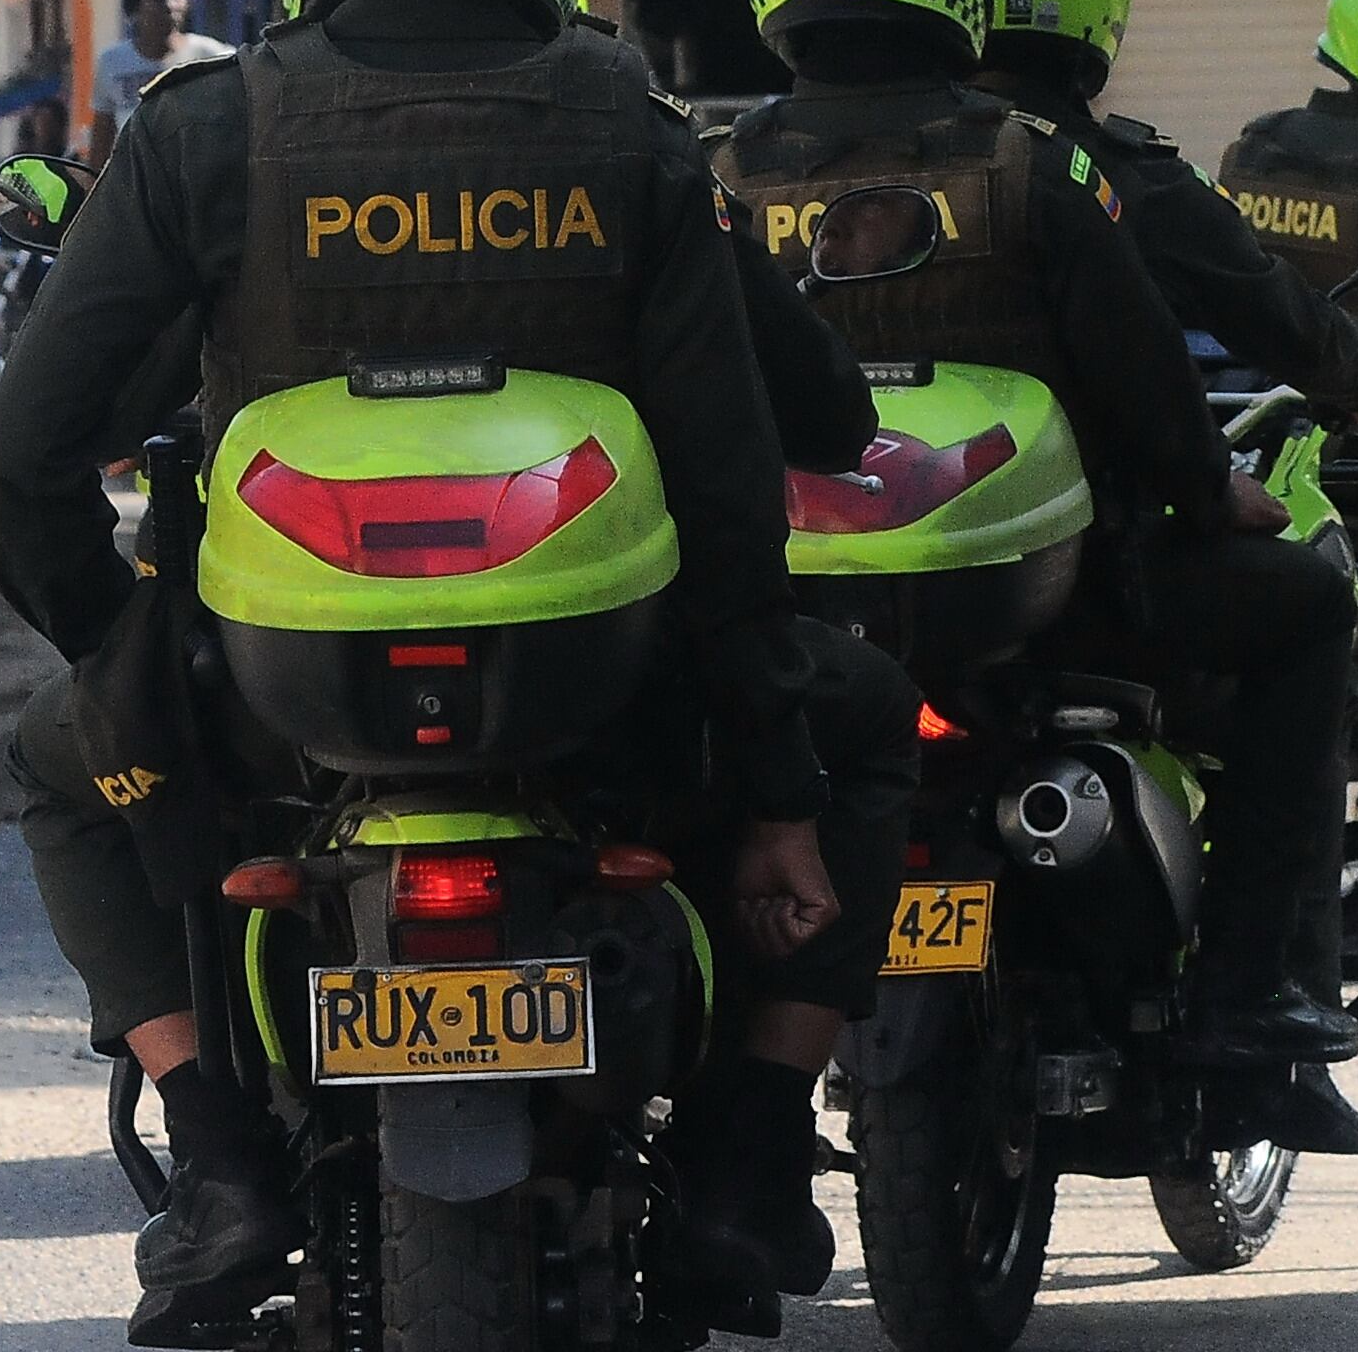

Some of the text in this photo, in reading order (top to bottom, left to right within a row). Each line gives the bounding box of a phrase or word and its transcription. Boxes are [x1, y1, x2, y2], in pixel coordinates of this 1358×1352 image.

[305, 186, 607, 259] POLICIA
[1237, 191, 1338, 243] POLICIA
[897, 897, 986, 949] 42F
[326, 986, 438, 1052] RUX
[406, 1050, 501, 1066] COLOMBIA
